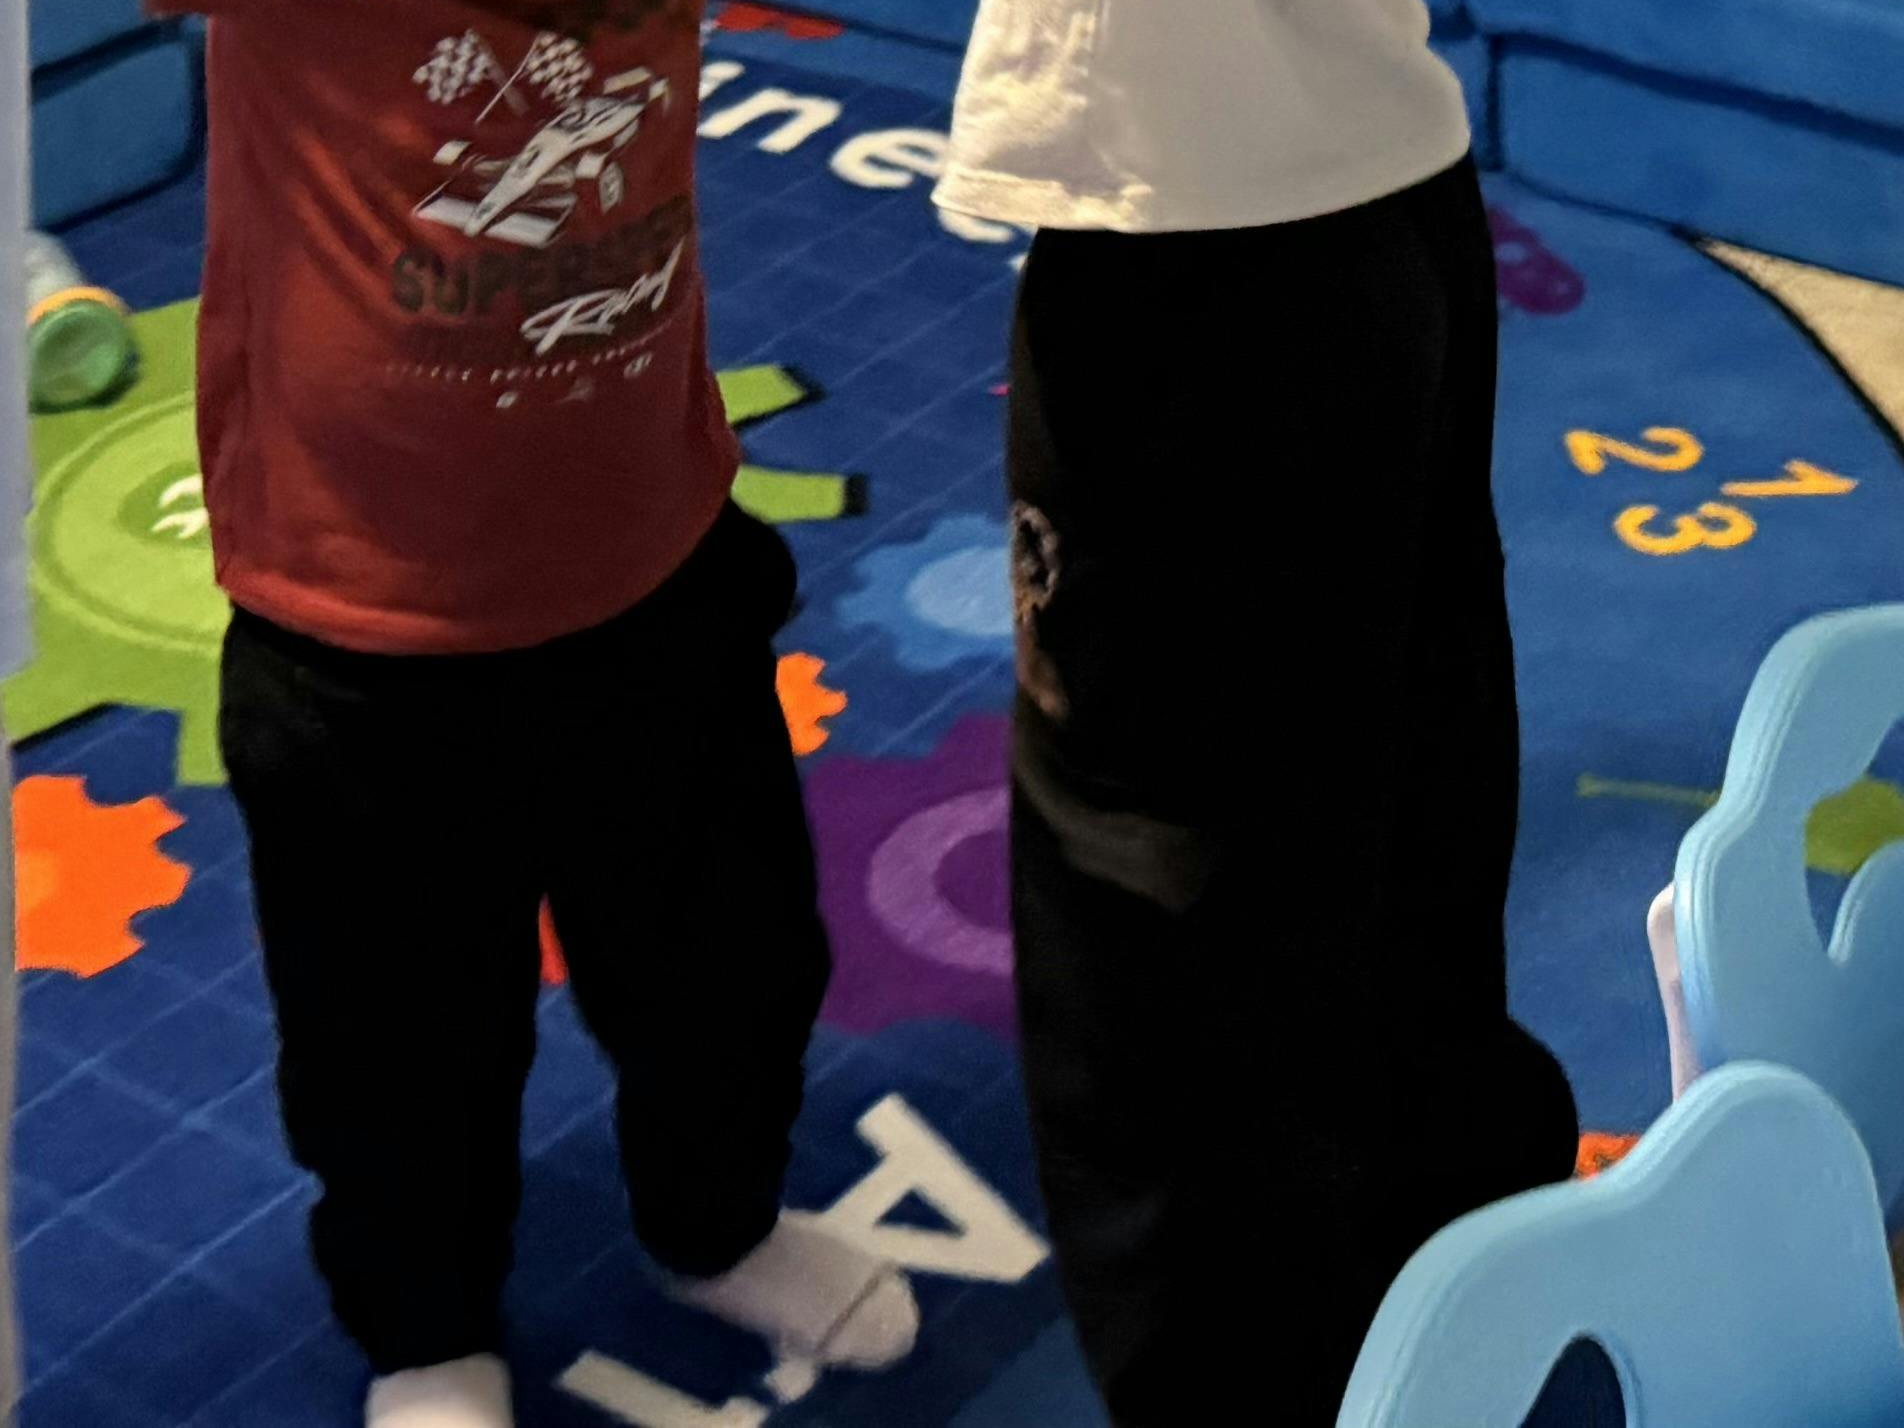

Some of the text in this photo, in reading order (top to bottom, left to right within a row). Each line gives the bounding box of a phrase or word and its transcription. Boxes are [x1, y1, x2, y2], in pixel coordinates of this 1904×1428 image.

[1565, 427, 1704, 475] 2
[1720, 459, 1859, 497] 1
[1613, 501, 1757, 556] 3
